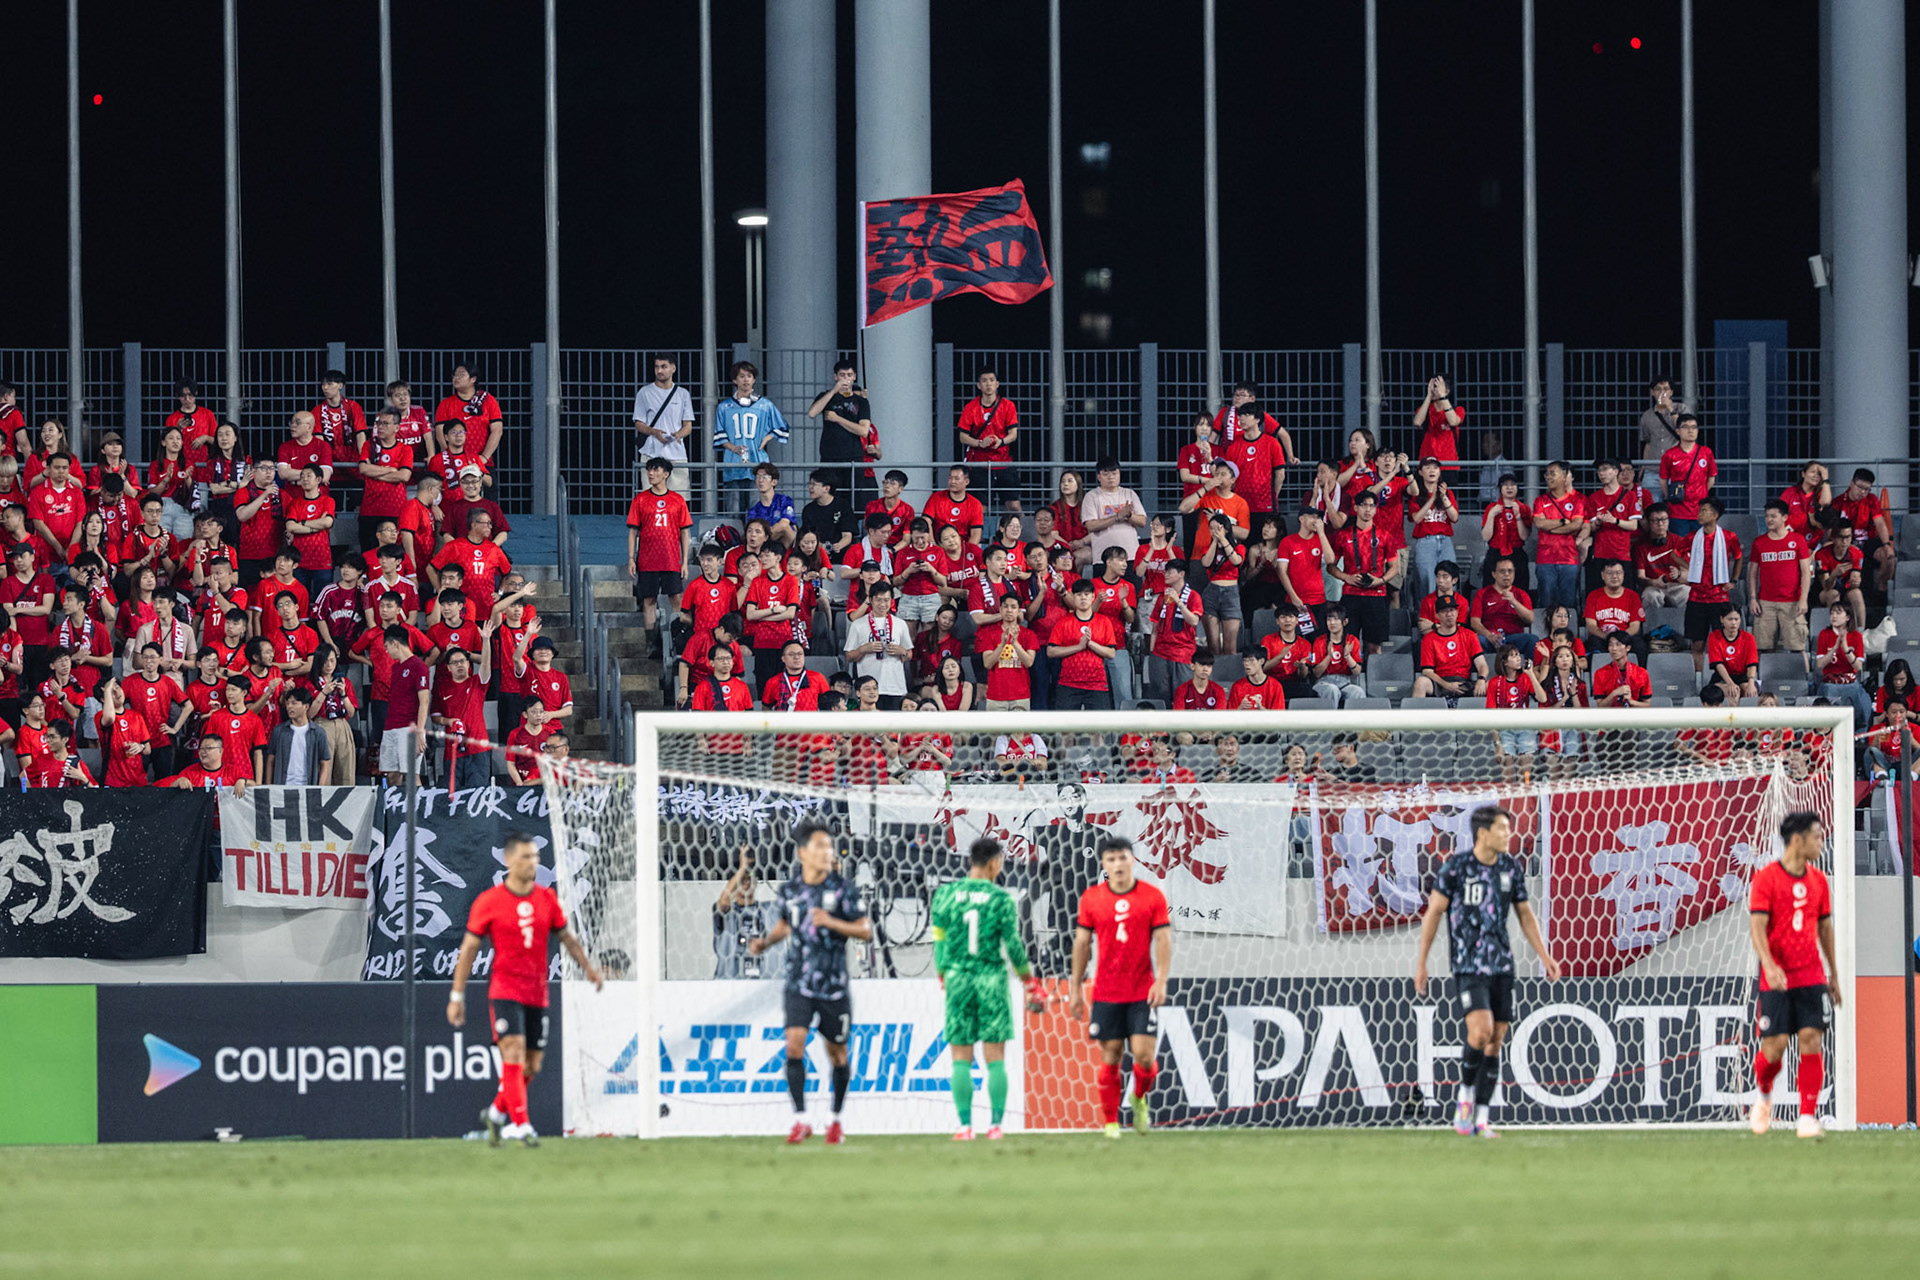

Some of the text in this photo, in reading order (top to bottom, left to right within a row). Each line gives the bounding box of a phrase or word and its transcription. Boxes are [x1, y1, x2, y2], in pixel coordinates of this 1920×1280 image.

[732, 412, 758, 440] 10
[654, 513, 668, 527] 21
[472, 562, 485, 575] 17
[1761, 550, 1796, 562] HONG KONG
[1596, 608, 1631, 623] HONG KONG
[254, 786, 356, 842] HK
[448, 786, 513, 820] FOR
[0, 799, 137, 925] 波
[225, 847, 300, 896] TILL
[316, 852, 371, 899] DIE
[962, 908, 979, 956] 1
[215, 1045, 406, 1093] coupang
[1121, 1003, 1836, 1109] APA HOTEL
